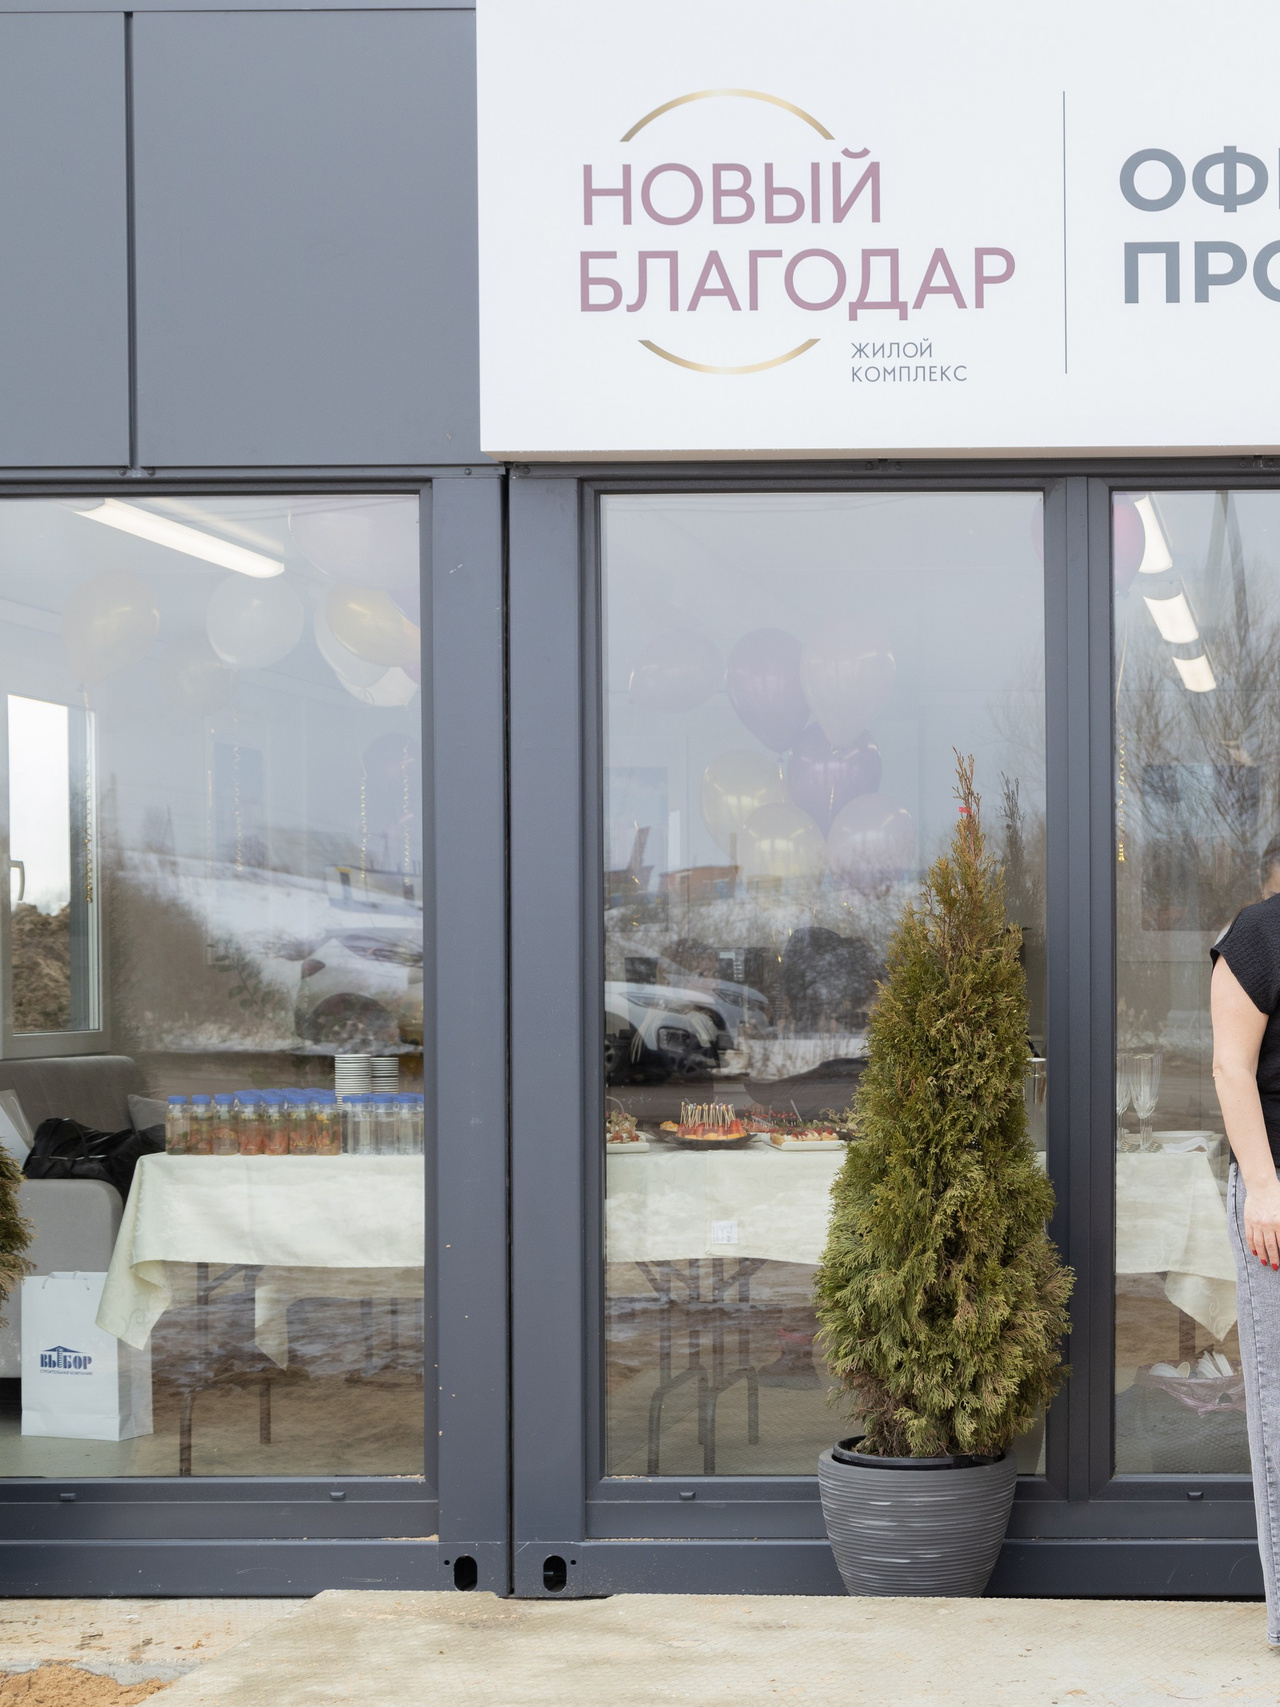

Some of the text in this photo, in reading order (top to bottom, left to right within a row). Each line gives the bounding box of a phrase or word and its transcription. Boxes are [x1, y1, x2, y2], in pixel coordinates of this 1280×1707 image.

[582, 147, 881, 226] НОВЫЙ
[579, 247, 1016, 322] БЛАГОДАР
[851, 338, 933, 359] ЖИЛОЙ
[851, 365, 967, 382] КОМПЛЕКС
[40, 1353, 92, 1369] ВЫБОР
